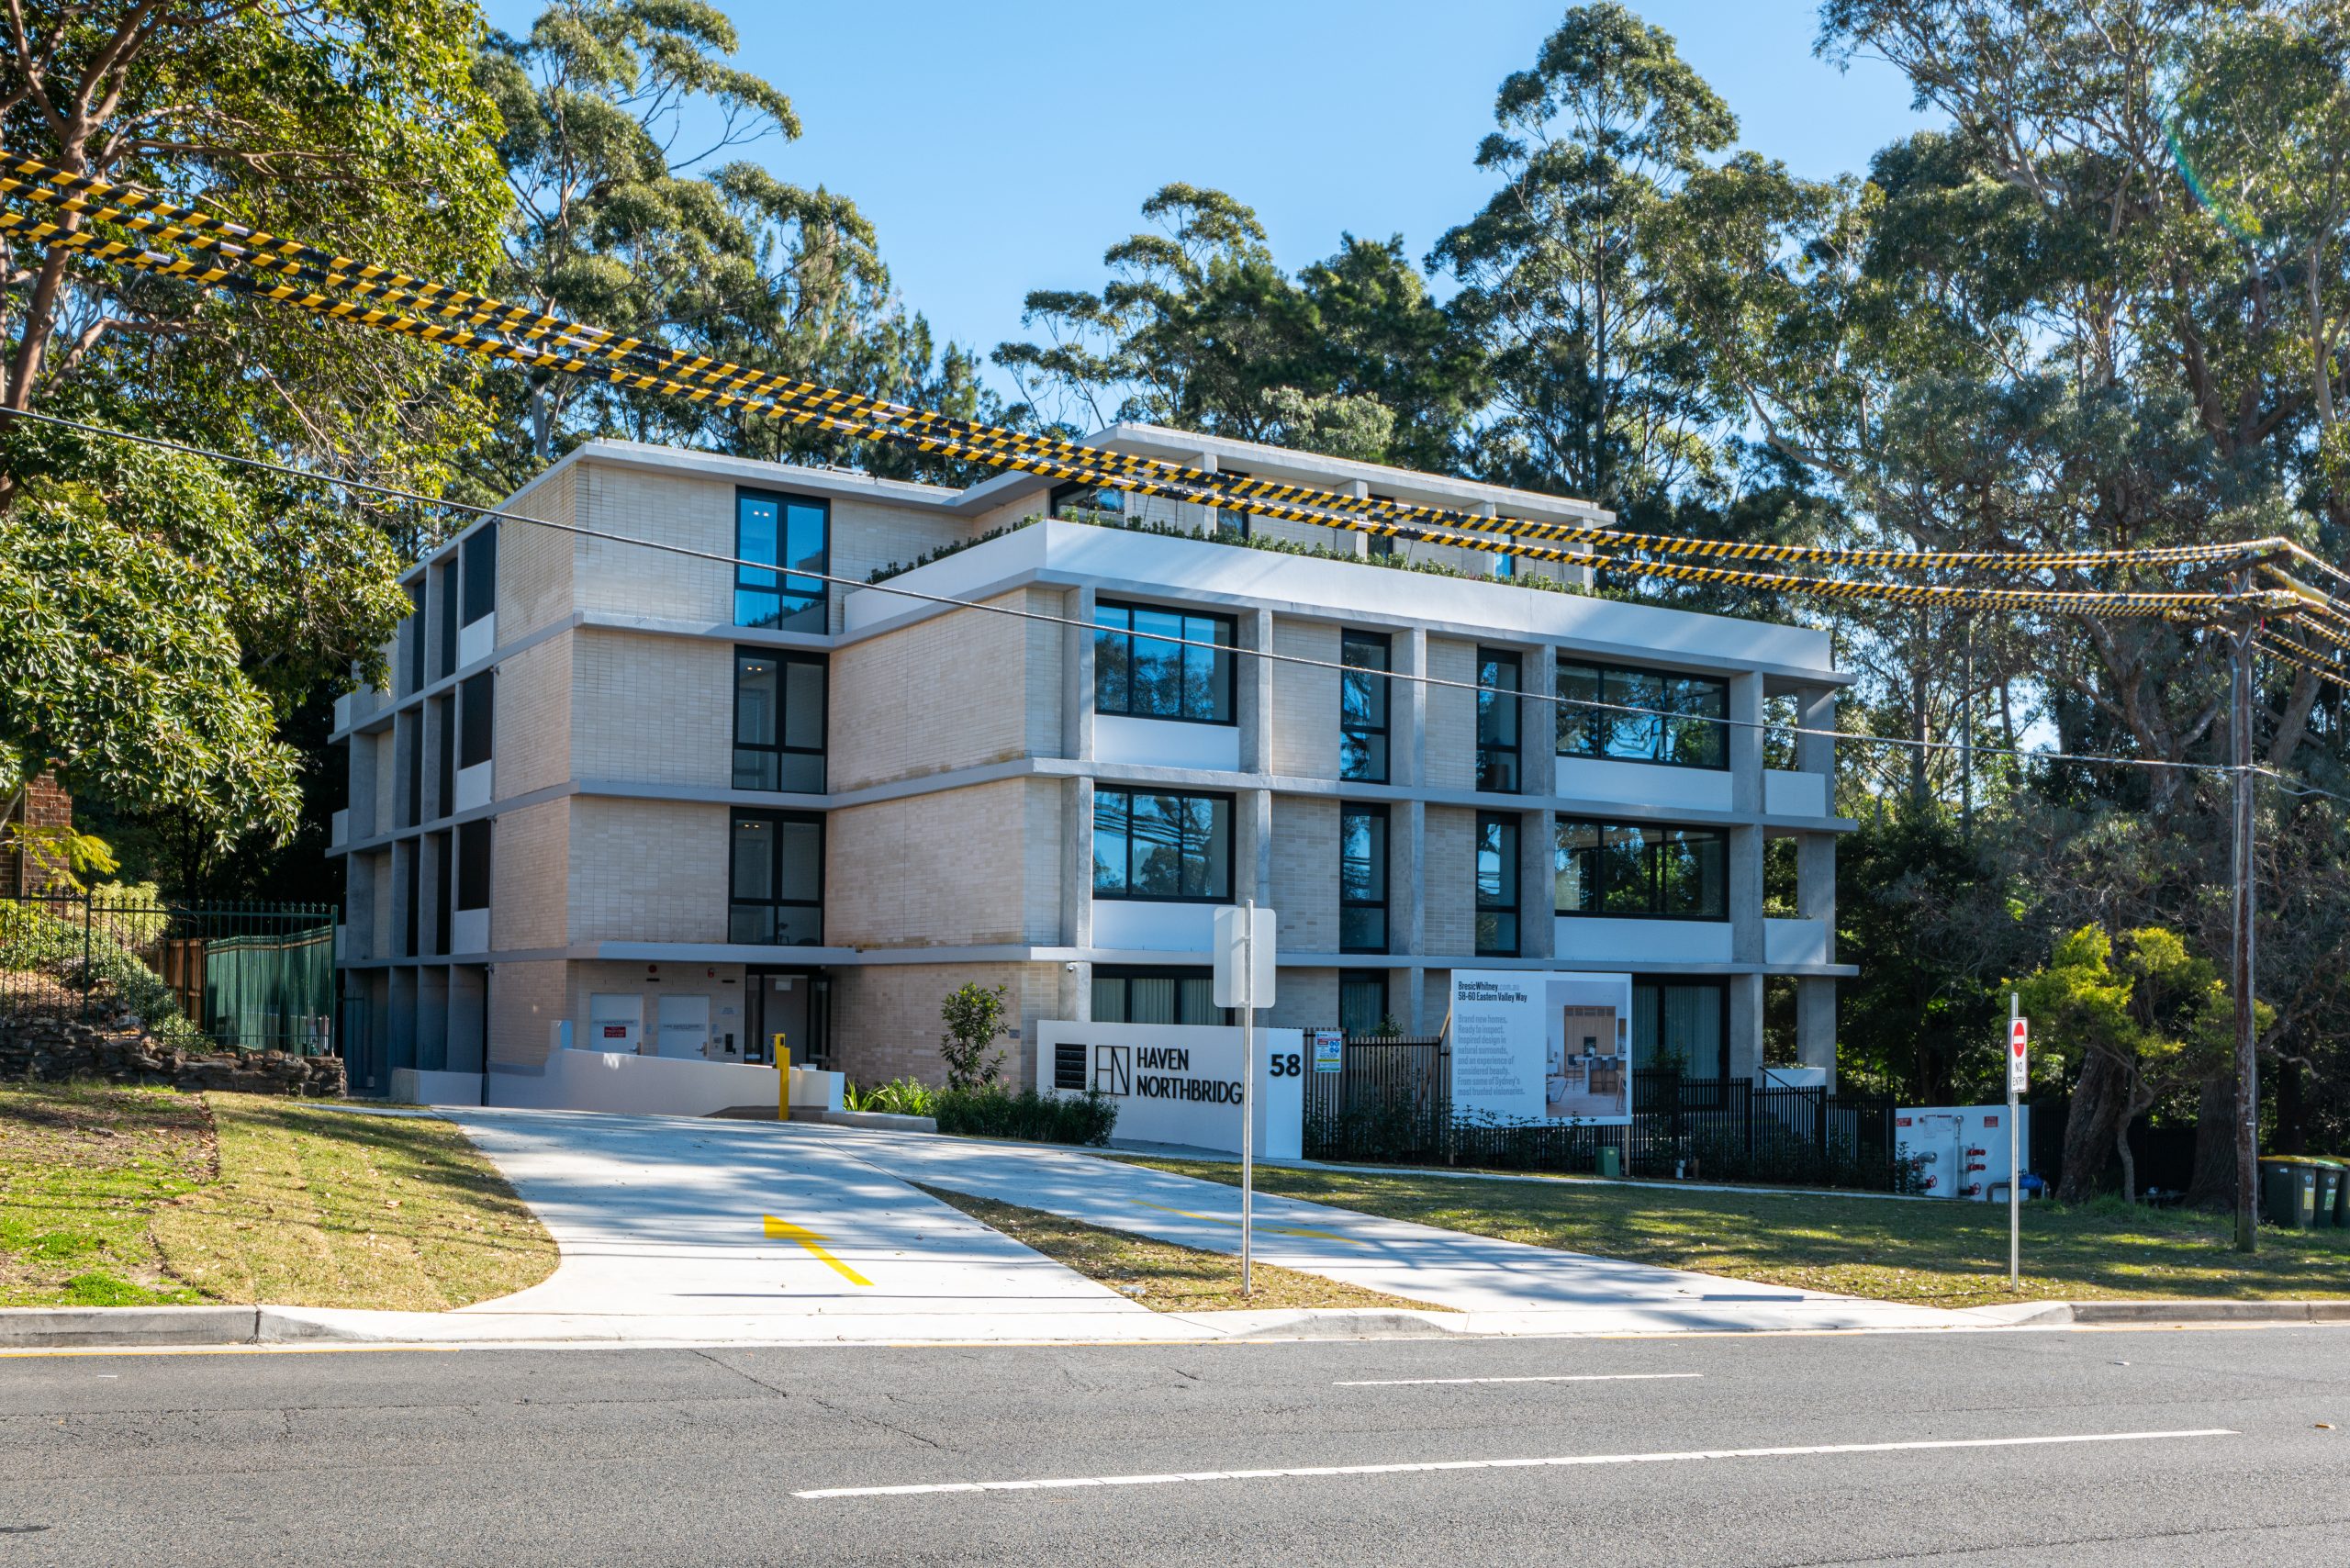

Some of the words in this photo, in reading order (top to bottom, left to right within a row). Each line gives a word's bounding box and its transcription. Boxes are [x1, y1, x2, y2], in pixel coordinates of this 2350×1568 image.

[1458, 991, 1476, 1001] 58-60
[1476, 991, 1497, 1002] Eastern
[1498, 992, 1515, 1002] Valley
[1515, 992, 1528, 1002] Way
[1458, 1014, 1474, 1024] Brand
[1488, 1014, 1507, 1024] homes.
[1458, 1025, 1475, 1036] Ready
[1482, 1025, 1505, 1036] inspect.
[1458, 1035, 1481, 1045] Inspired
[1481, 1036, 1500, 1046] design
[1501, 1036, 1506, 1044] in
[1458, 1046, 1478, 1055] natural
[1136, 1047, 1189, 1070] HAVEN
[1458, 1056, 1469, 1065] and
[1476, 1056, 1507, 1067] experience
[1508, 1056, 1515, 1065] of
[1270, 1053, 1302, 1077] 58
[1457, 1066, 1488, 1075] considered
[2014, 1061, 2023, 1073] NO
[1457, 1076, 1472, 1085] From
[1472, 1078, 1488, 1086] some
[1489, 1076, 1494, 1085] of
[1494, 1076, 1520, 1087] Sydney's
[2013, 1077, 2025, 1087] ENTRY
[1457, 1087, 1472, 1096] most
[1472, 1086, 1493, 1096] trusted
